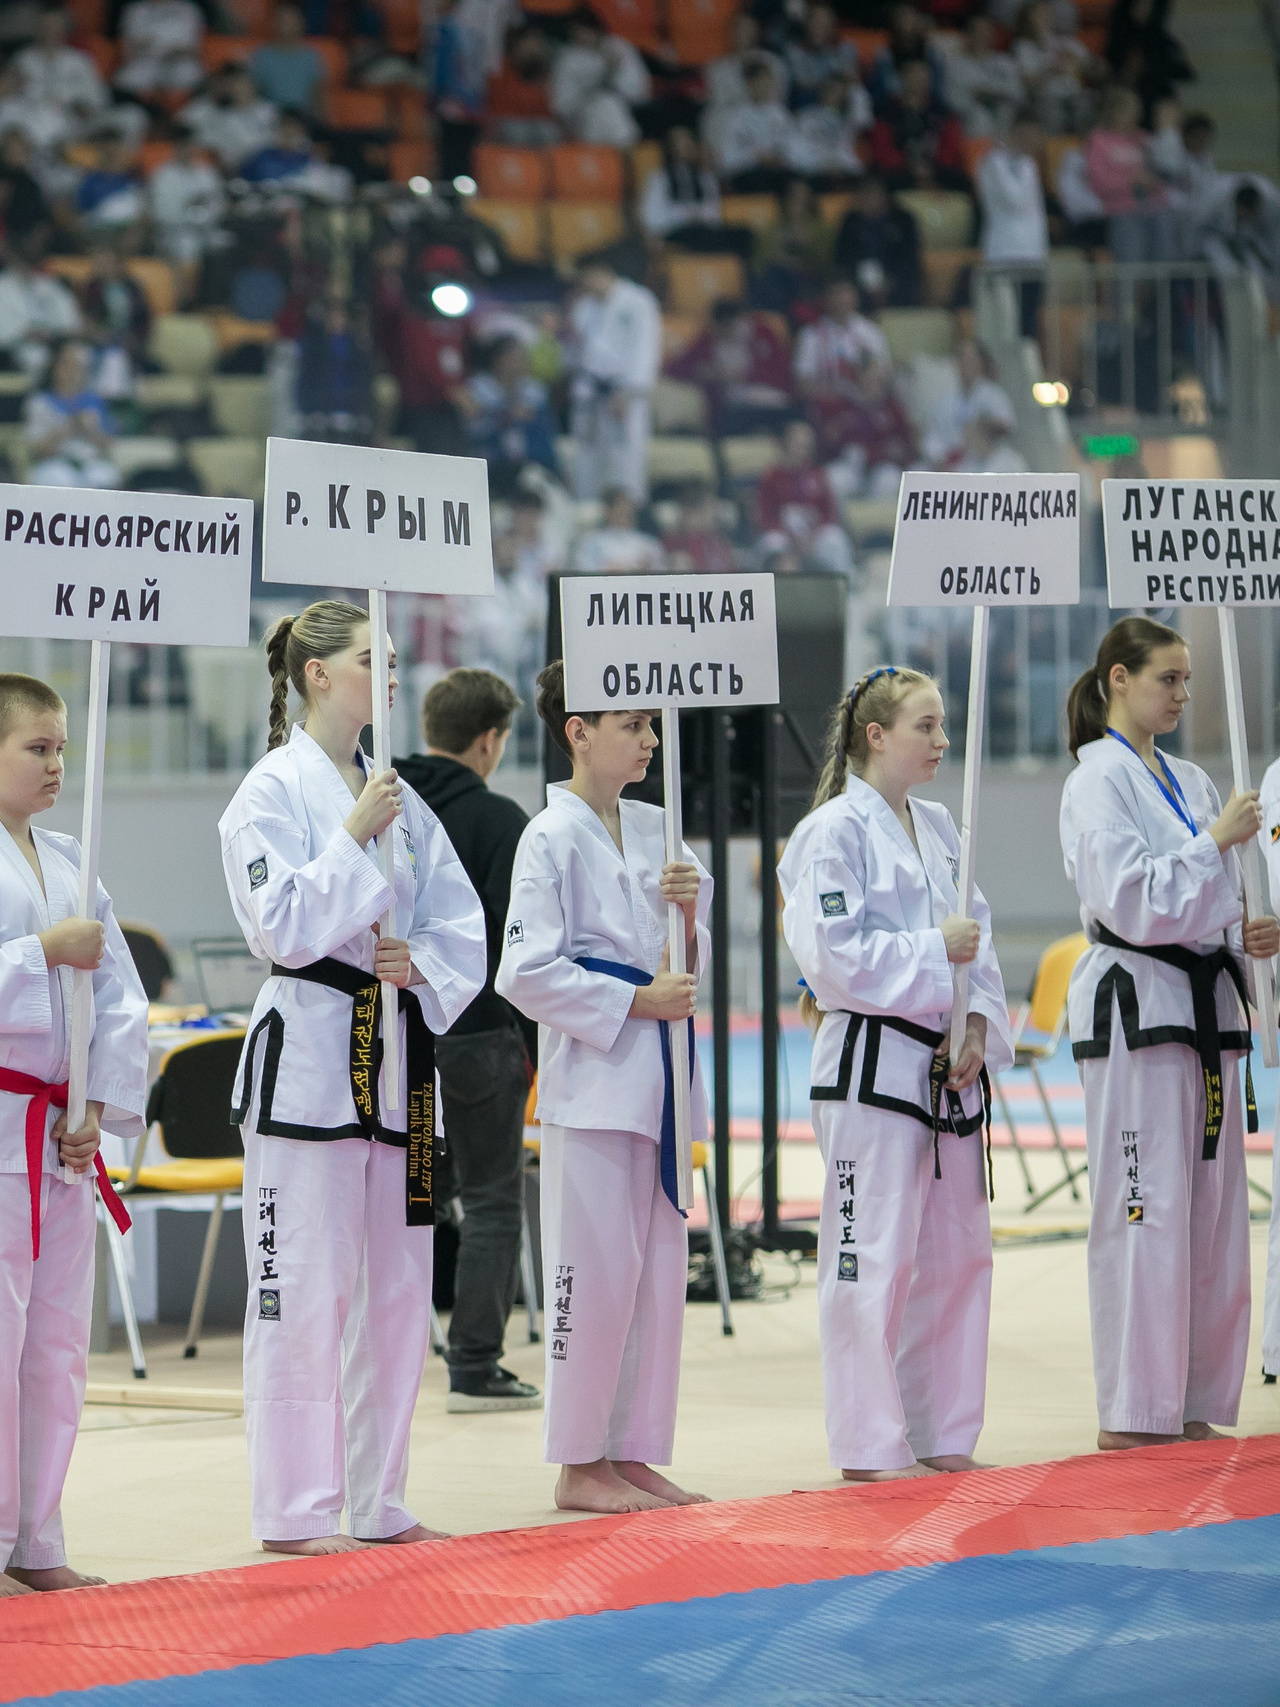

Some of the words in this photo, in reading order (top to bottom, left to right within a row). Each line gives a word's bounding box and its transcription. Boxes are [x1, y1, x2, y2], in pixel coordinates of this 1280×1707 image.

[328, 483, 471, 547] КРЫМ
[902, 489, 1077, 527] ЛЕНИНГРАДСКАЯ
[940, 565, 1041, 595] ОБЛАСТЬ
[54, 577, 161, 622] КРАЙ
[586, 588, 755, 634] ЛИПЕЦКАЯ
[602, 661, 744, 698] ОБЛАСТЬ
[408, 1091, 422, 1129] Lapik
[422, 1082, 433, 1168] TAEKWON-DO
[409, 1133, 422, 1177] Darina
[1122, 1131, 1138, 1142] ITF
[421, 1169, 432, 1192] ITF
[836, 1160, 856, 1171] ITF
[259, 1187, 278, 1199] ITF
[839, 1173, 856, 1245] 태권도
[258, 1202, 279, 1281] 태권도
[556, 1265, 575, 1274] ITF
[552, 1275, 574, 1332] 태권도
